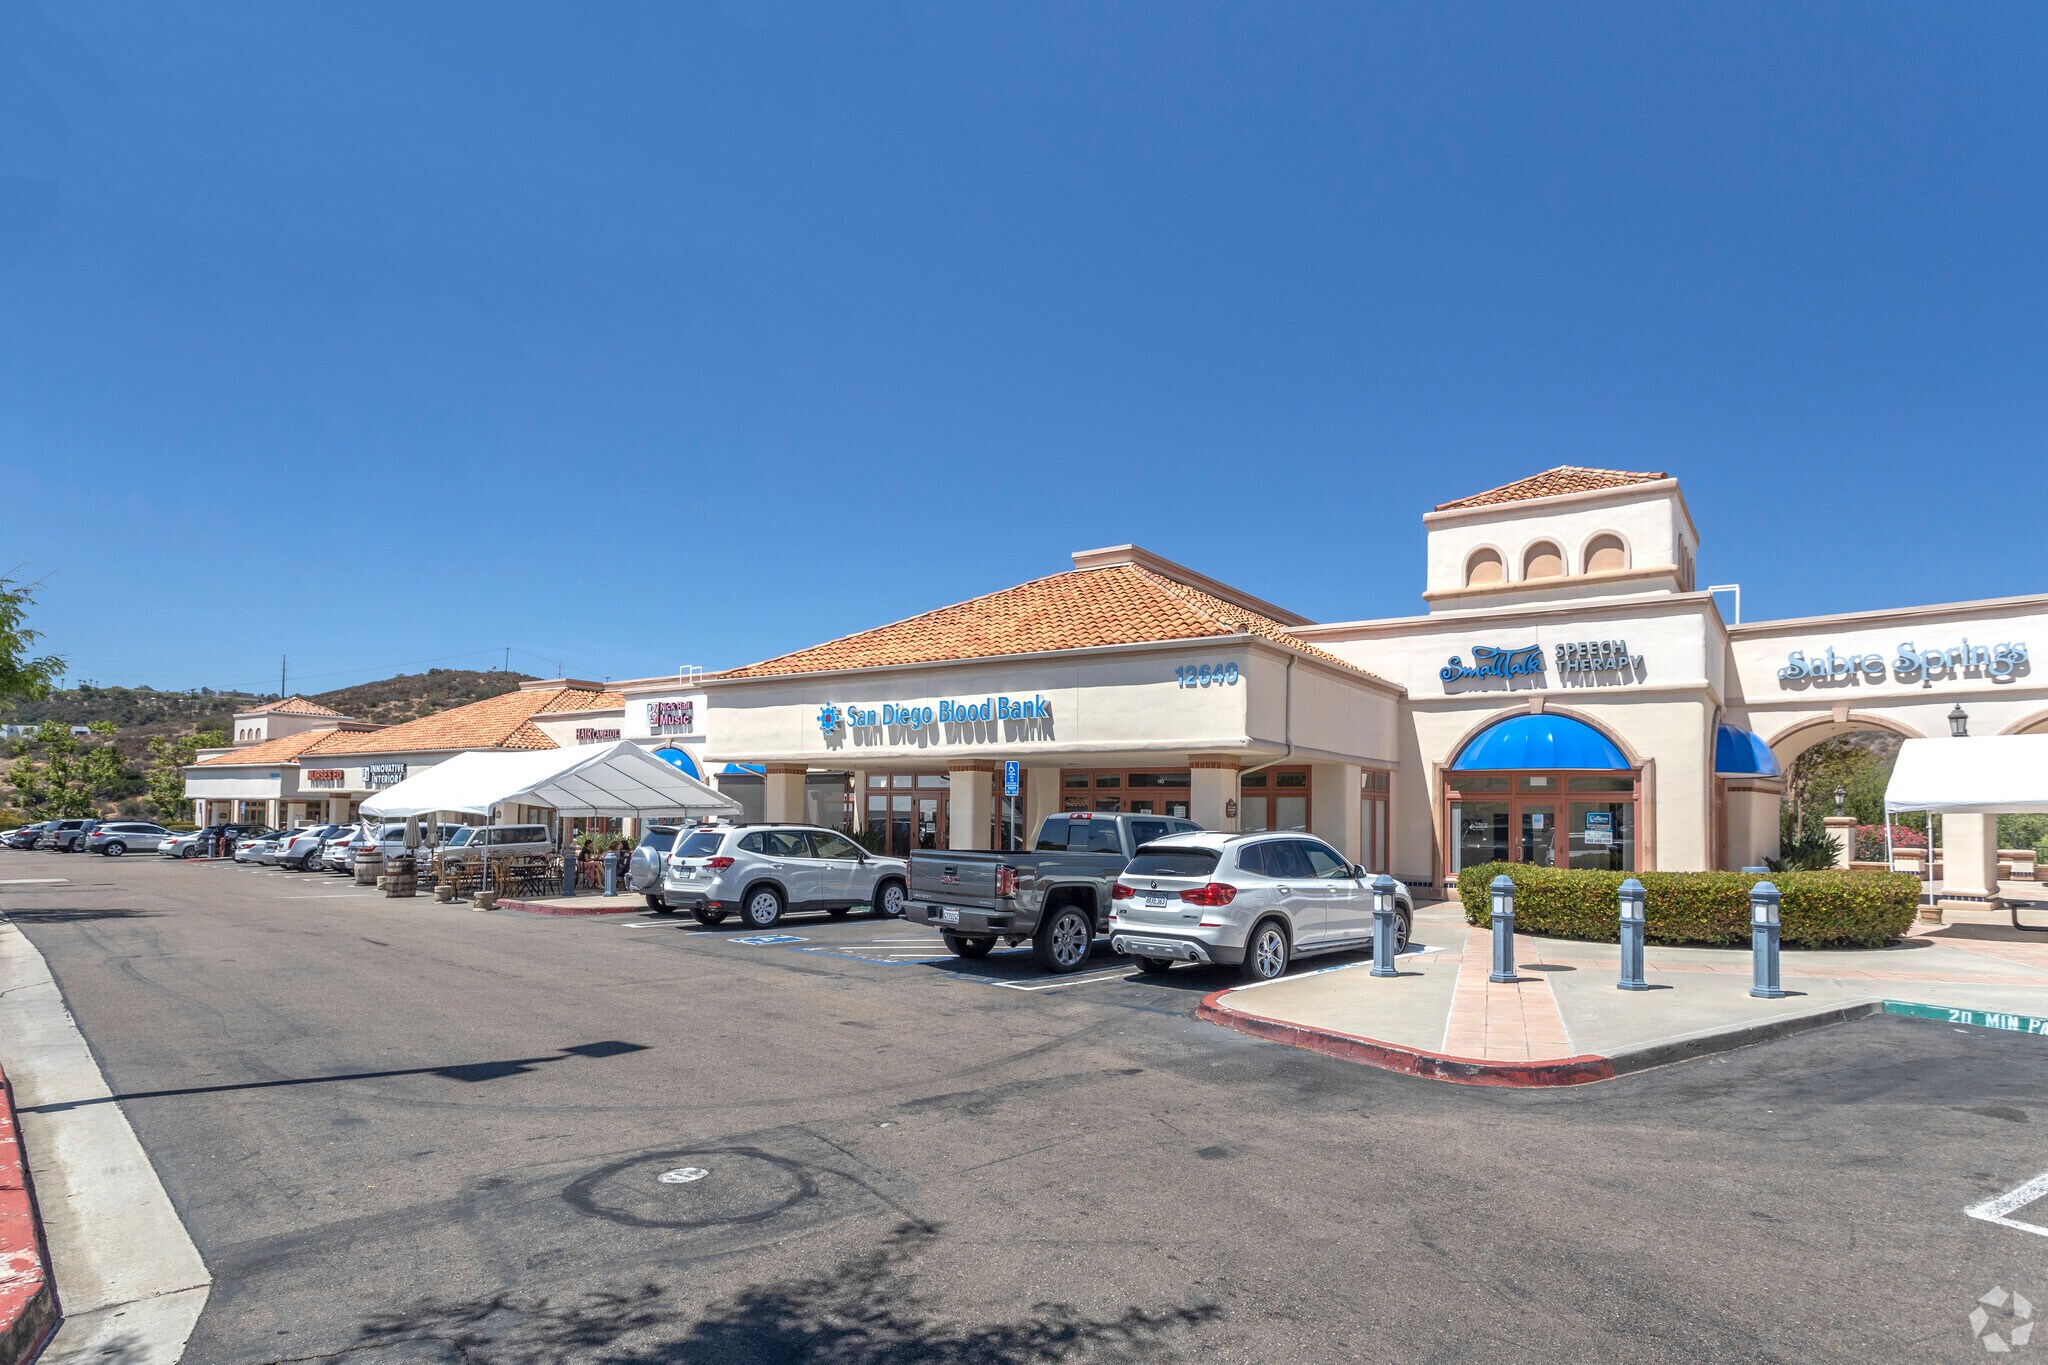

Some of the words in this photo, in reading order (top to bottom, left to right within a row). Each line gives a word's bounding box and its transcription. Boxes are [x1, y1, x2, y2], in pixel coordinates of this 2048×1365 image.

[1555, 640, 1627, 657] SPEECH
[1556, 655, 1645, 674] THERAPY
[1777, 645, 1884, 680] Sabre
[1892, 637, 2027, 681] Springs
[1175, 662, 1239, 686] 12640
[660, 702, 675, 711] Nick
[847, 706, 877, 728] San
[883, 703, 933, 730] Diego
[939, 697, 991, 723] Blood
[998, 695, 1048, 720] Bank
[660, 715, 689, 725] Music
[576, 729, 594, 740] HAIR
[308, 770, 333, 780] NURSES
[333, 770, 342, 780] ED
[370, 764, 404, 772] INNOVATIVE
[1949, 1009, 1972, 1024] 20
[1985, 1013, 2019, 1030] MIN
